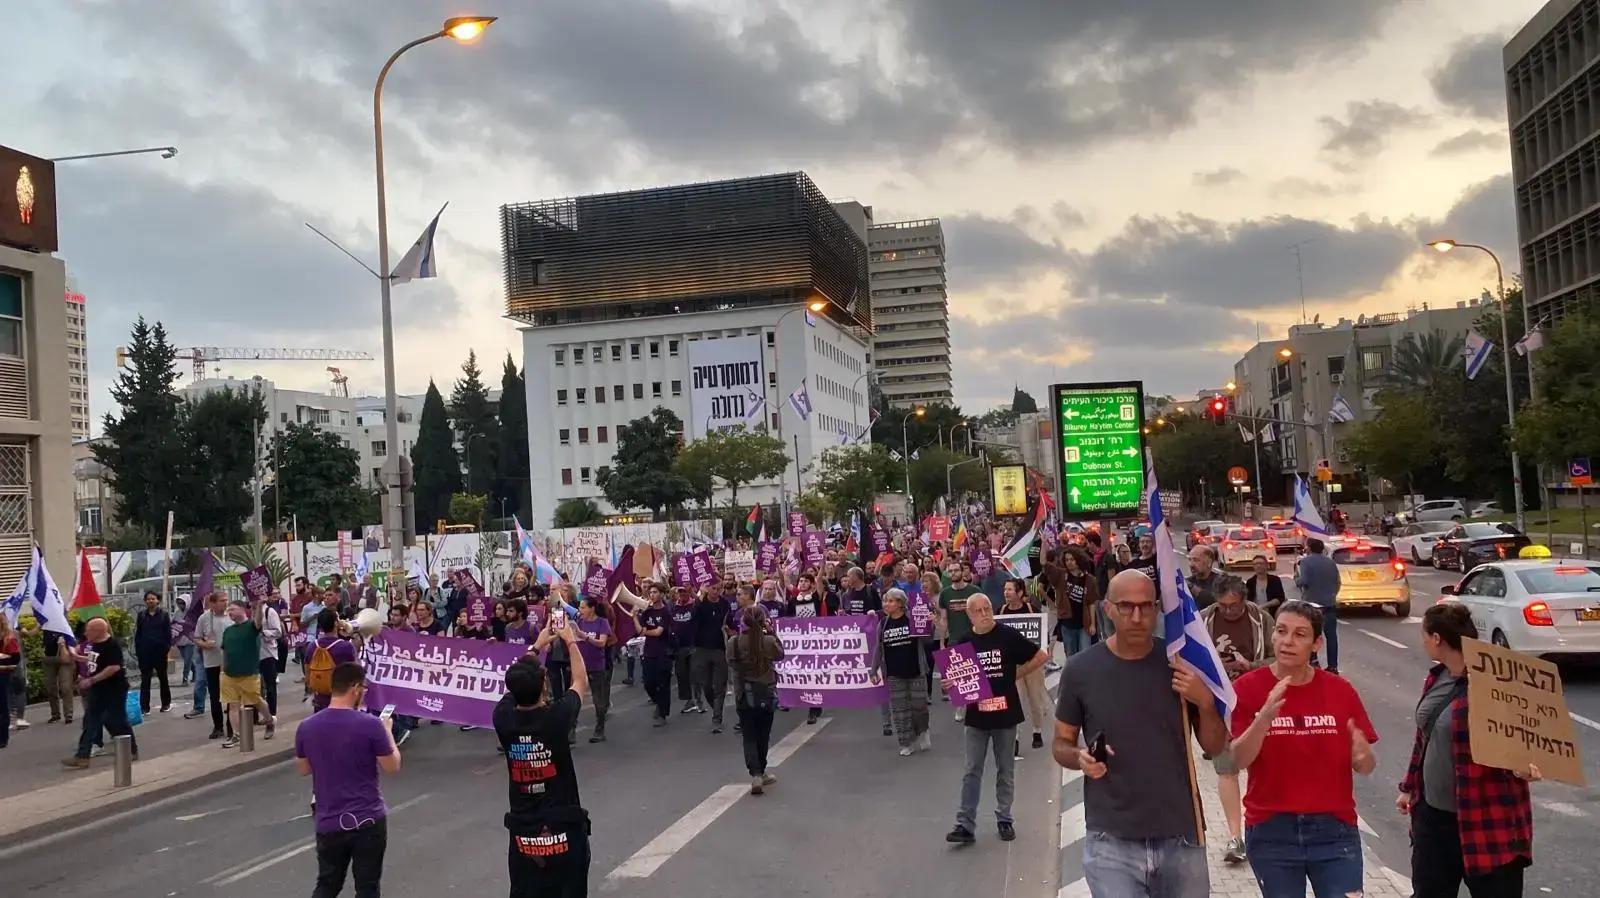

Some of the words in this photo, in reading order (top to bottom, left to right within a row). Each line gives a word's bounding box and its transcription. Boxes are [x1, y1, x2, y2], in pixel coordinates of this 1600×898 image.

[693, 361, 759, 389] דמוקרטיה
[712, 394, 745, 419] גדולה
[1063, 397, 1090, 405] העיתים
[1064, 424, 1087, 432] Bikurey
[1079, 437, 1104, 445] דובנוב
[1083, 478, 1115, 486] התרבות
[1118, 476, 1137, 484] היכל
[1111, 501, 1139, 509] Hatarbut
[1003, 622, 1028, 630] דמוק
[1028, 621, 1039, 630] אין
[1026, 630, 1039, 638] עם
[783, 639, 799, 650] עם
[802, 638, 840, 650] שכובש
[843, 638, 861, 650] עם
[391, 644, 411, 664] مع
[414, 643, 494, 673] ديمقراطية
[976, 651, 991, 659] דמוק
[991, 648, 1001, 658] אין
[428, 668, 453, 687] לא
[786, 672, 812, 684] יהיה
[815, 672, 831, 684] לא
[1472, 652, 1555, 693] הציונות
[456, 673, 475, 690] זה
[959, 683, 978, 693] בעזה
[1491, 688, 1528, 709] כרסום
[1536, 703, 1558, 718] היא
[1271, 716, 1295, 728] הנש
[1303, 715, 1337, 727] מאבק
[1517, 713, 1540, 728] יסוד
[519, 735, 532, 743] אם
[1487, 719, 1575, 758] הדמוקרטיה
[532, 742, 544, 752] לא
[527, 749, 552, 760] להיות
[520, 832, 567, 846] מושחתים
